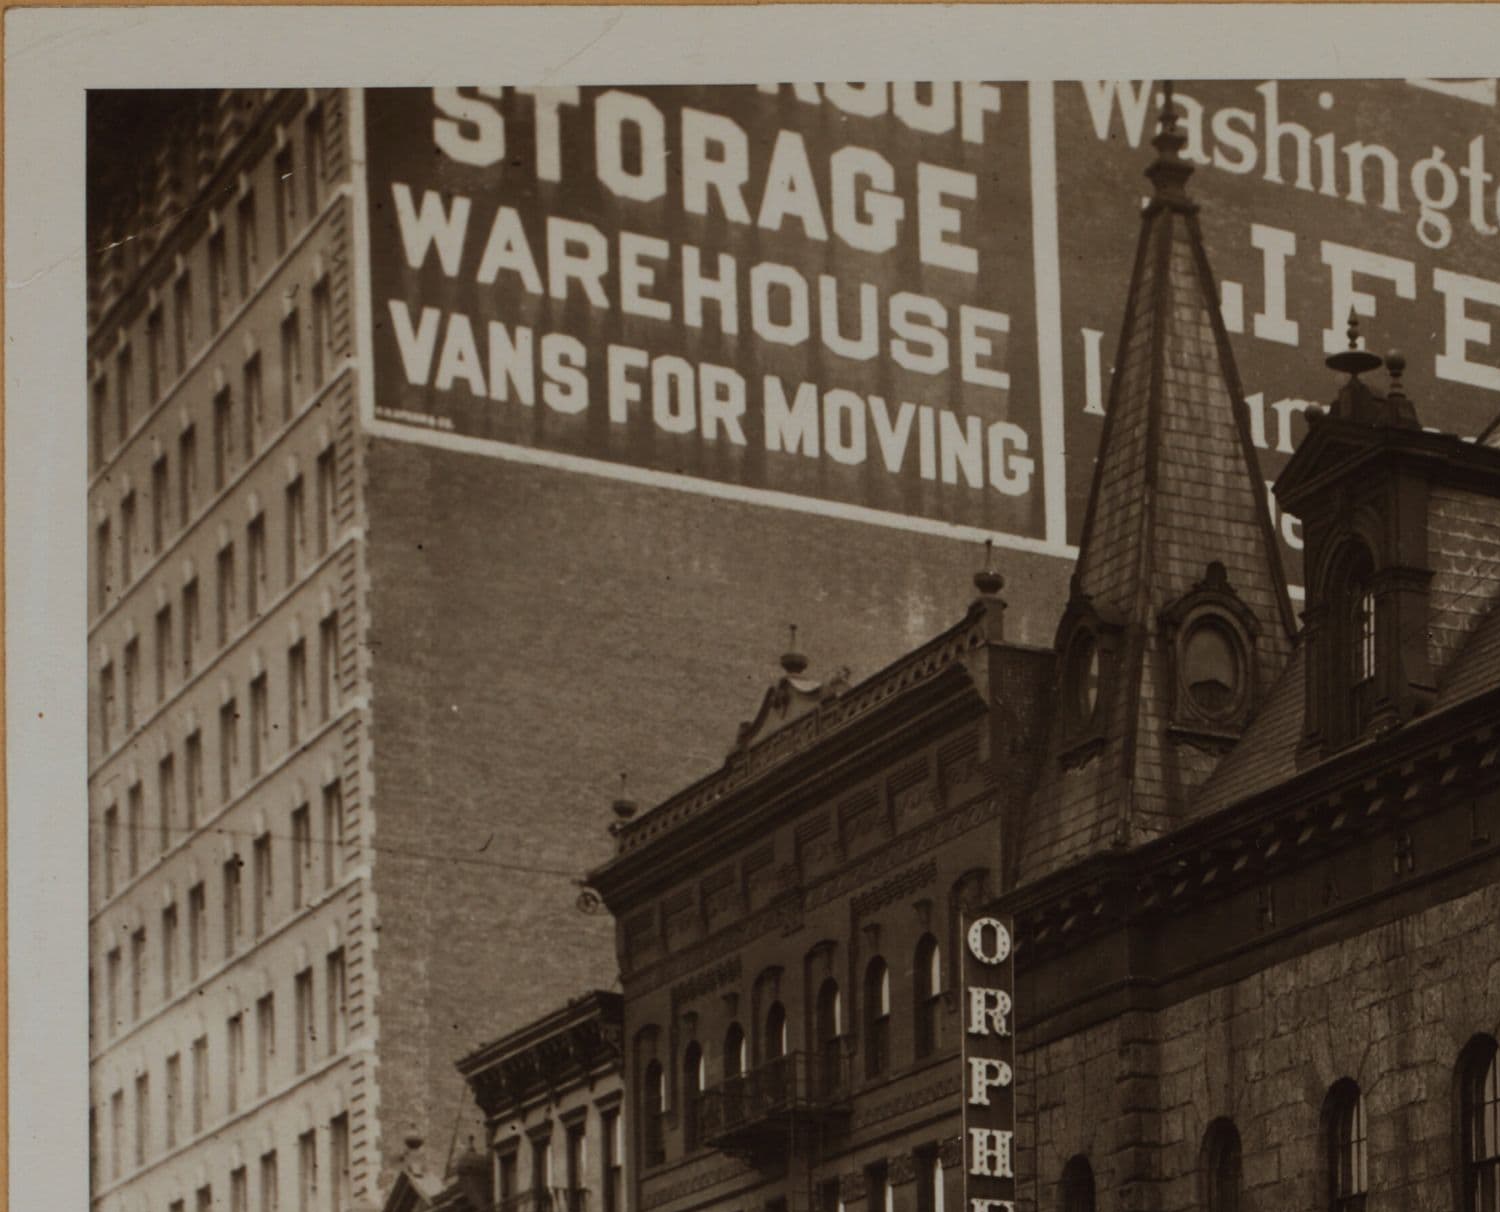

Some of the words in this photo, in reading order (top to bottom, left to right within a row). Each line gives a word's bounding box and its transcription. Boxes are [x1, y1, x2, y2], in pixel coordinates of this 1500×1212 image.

[432, 85, 980, 274] STORAGE
[392, 182, 1011, 390] WAREHOUSE
[389, 299, 590, 415] VANS
[607, 344, 747, 446] FOR
[764, 373, 1035, 497] MOVING
